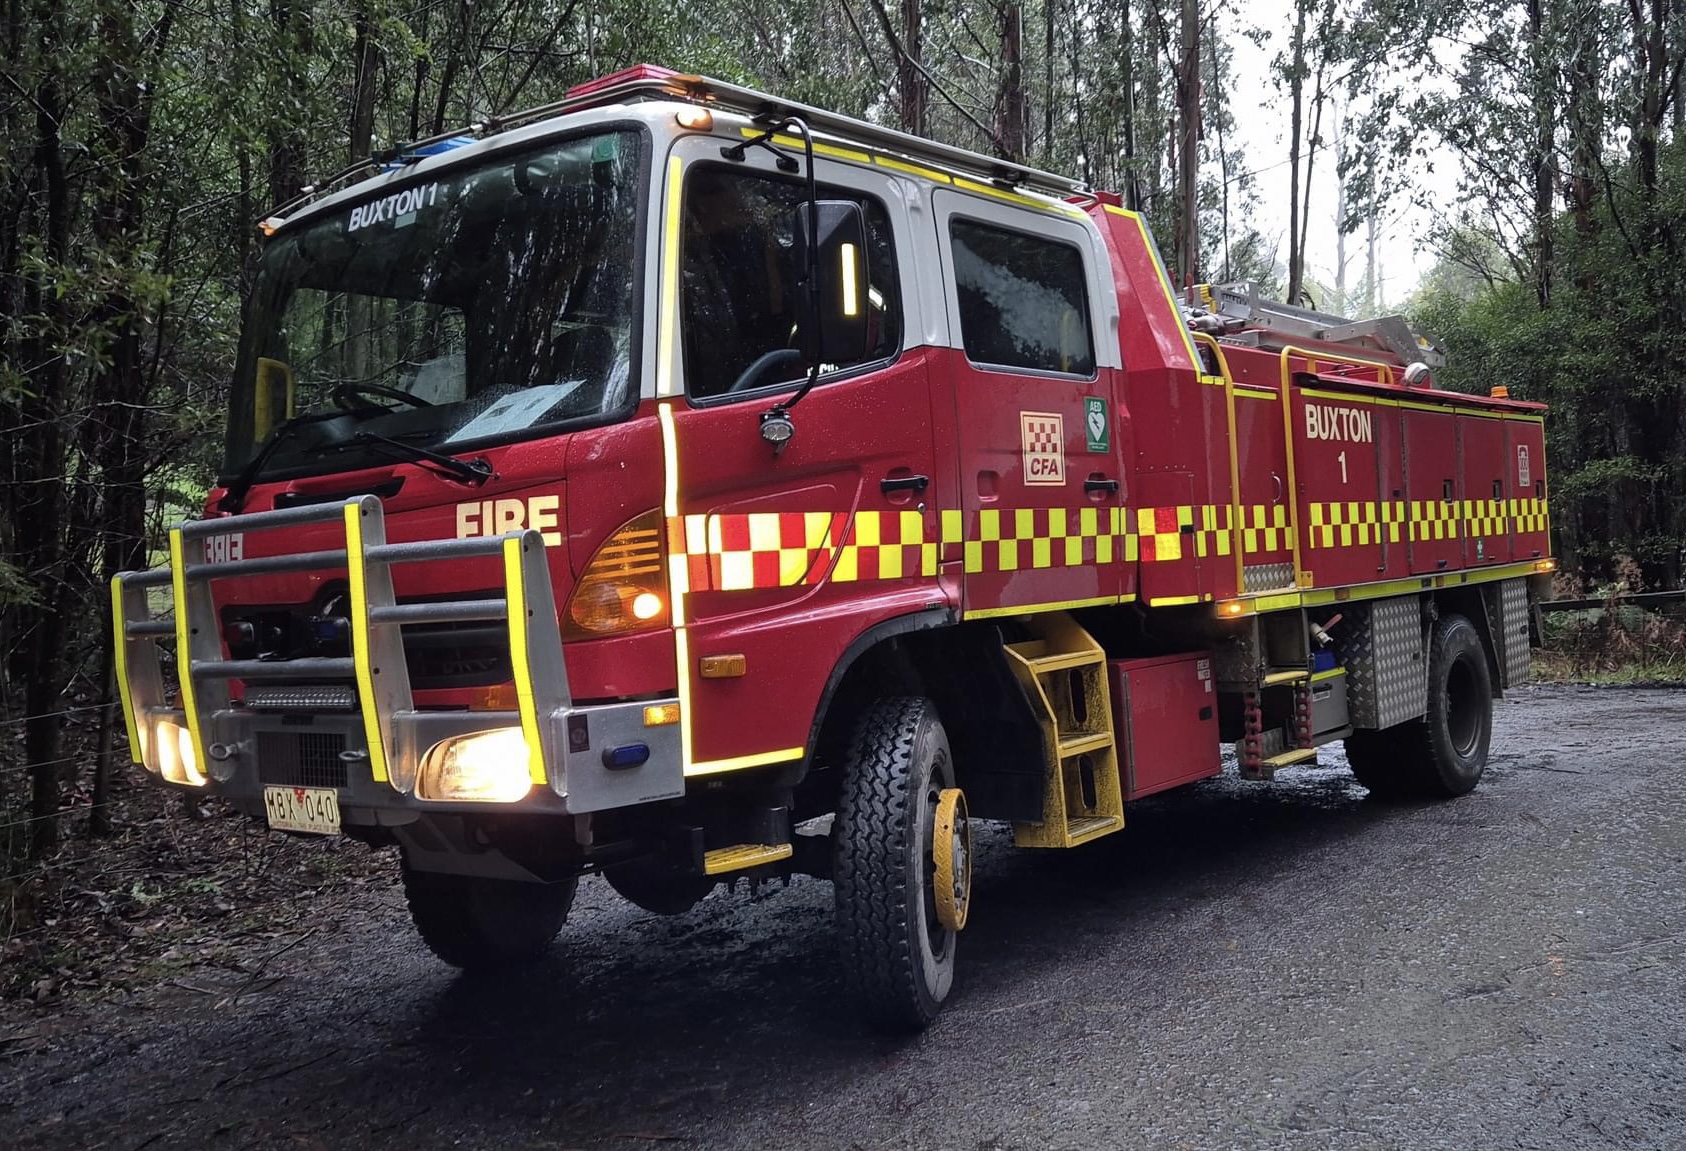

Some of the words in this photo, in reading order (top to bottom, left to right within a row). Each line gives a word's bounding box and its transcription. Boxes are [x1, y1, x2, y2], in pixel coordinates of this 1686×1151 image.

[347, 184, 426, 233] BUXTON
[428, 181, 438, 207] 1
[1089, 400, 1102, 412] AED
[1305, 403, 1373, 443] BUXTON
[1030, 458, 1059, 476] CFA
[1337, 450, 1347, 484] 1
[456, 495, 562, 547] FIRE
[266, 791, 298, 821] MBX
[305, 794, 335, 823] 040
